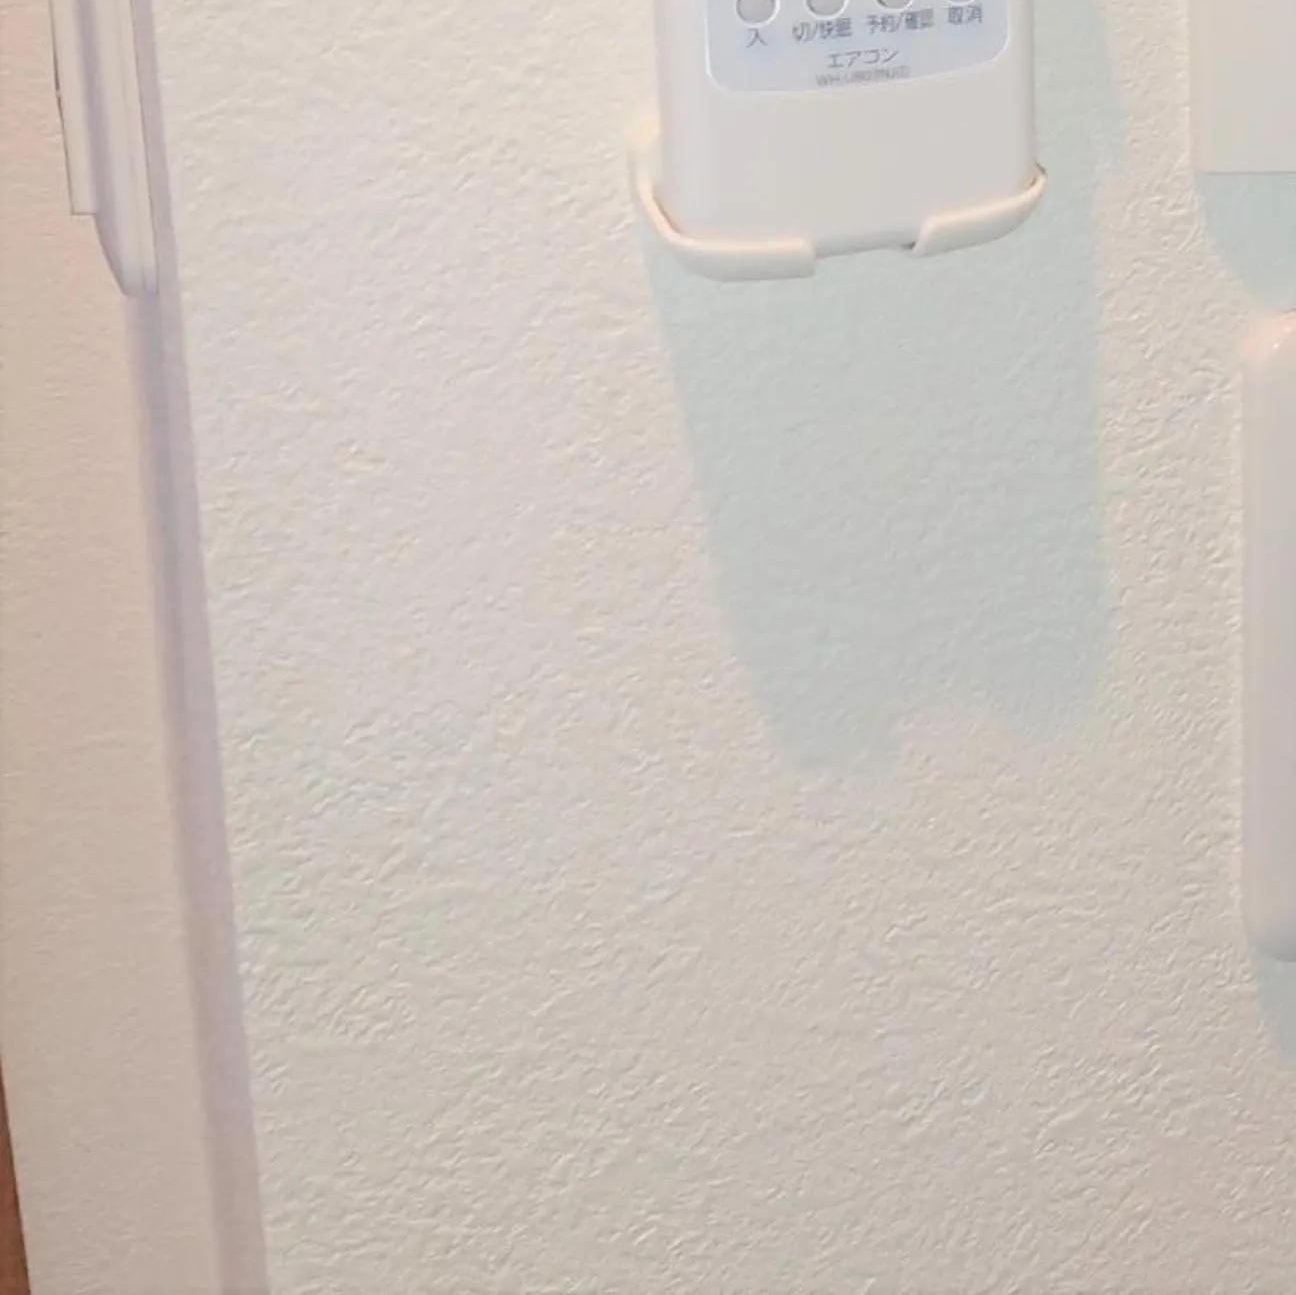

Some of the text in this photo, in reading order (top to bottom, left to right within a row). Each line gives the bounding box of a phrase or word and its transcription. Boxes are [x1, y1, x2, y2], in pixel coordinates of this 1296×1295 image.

[746, 28, 768, 48] 入
[826, 48, 900, 68] エアコン
